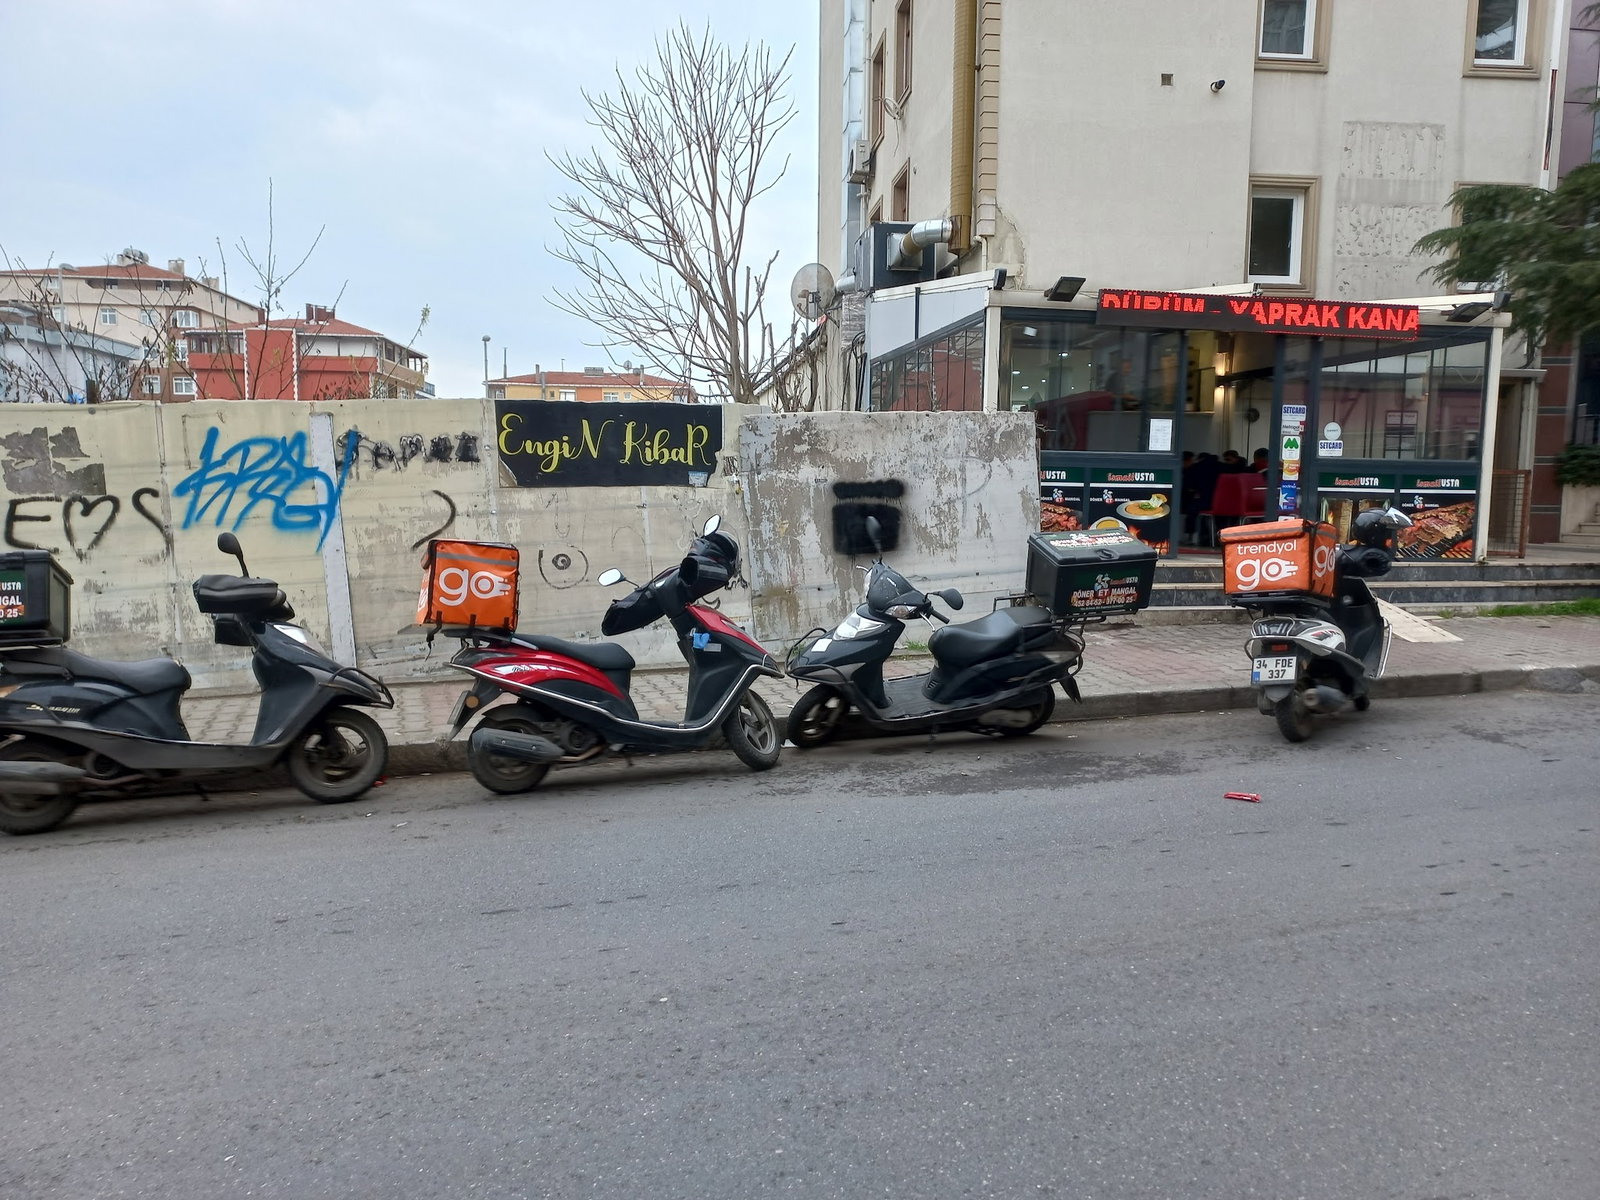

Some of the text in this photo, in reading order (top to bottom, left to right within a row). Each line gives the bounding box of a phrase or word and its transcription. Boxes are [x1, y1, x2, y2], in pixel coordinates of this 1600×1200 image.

[1230, 300, 1340, 328] YAPRAK
[1283, 406, 1305, 414] SETCARD
[618, 420, 712, 467] KibaR
[1320, 441, 1342, 449] SETCARD
[1237, 540, 1297, 555] trendyol
[1235, 557, 1298, 591] go
[438, 567, 511, 607] go
[1112, 586, 1136, 595] MANGAL
[1256, 658, 1294, 669] 34 FDE
[1268, 669, 1287, 679] 337
